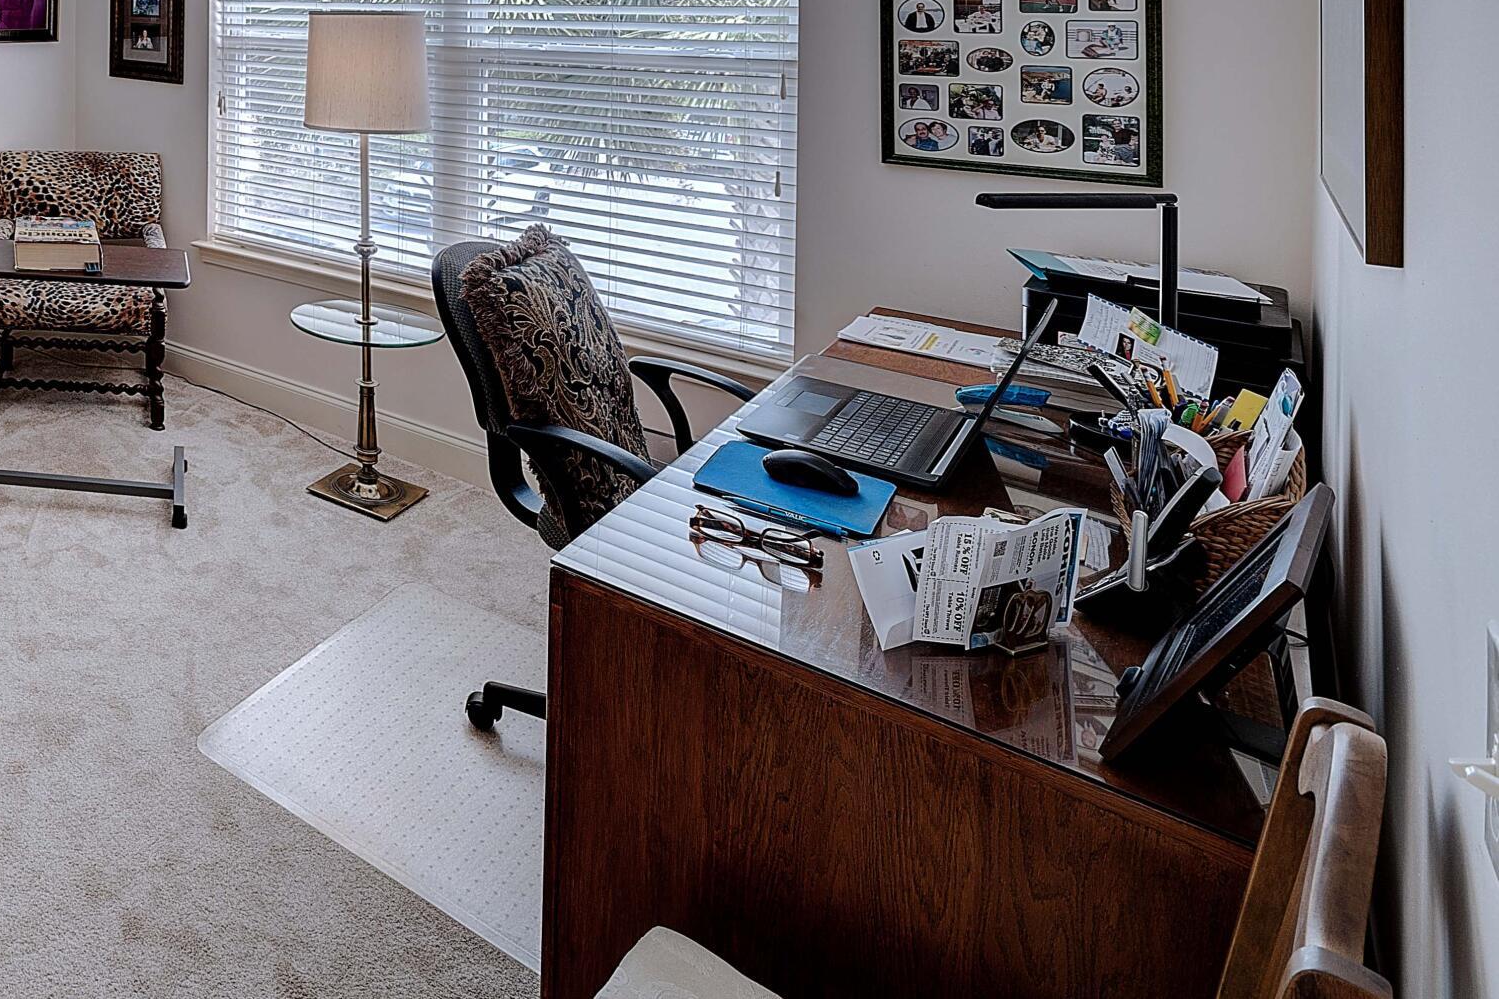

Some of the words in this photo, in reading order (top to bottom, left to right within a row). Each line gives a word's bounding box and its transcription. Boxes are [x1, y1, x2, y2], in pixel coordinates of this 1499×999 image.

[964, 533, 973, 545] 15
[952, 552, 961, 573] Runners
[1026, 532, 1039, 574] SONOMA
[960, 556, 970, 575] OFF
[955, 592, 965, 611] 10%
[953, 613, 963, 633] OFF
